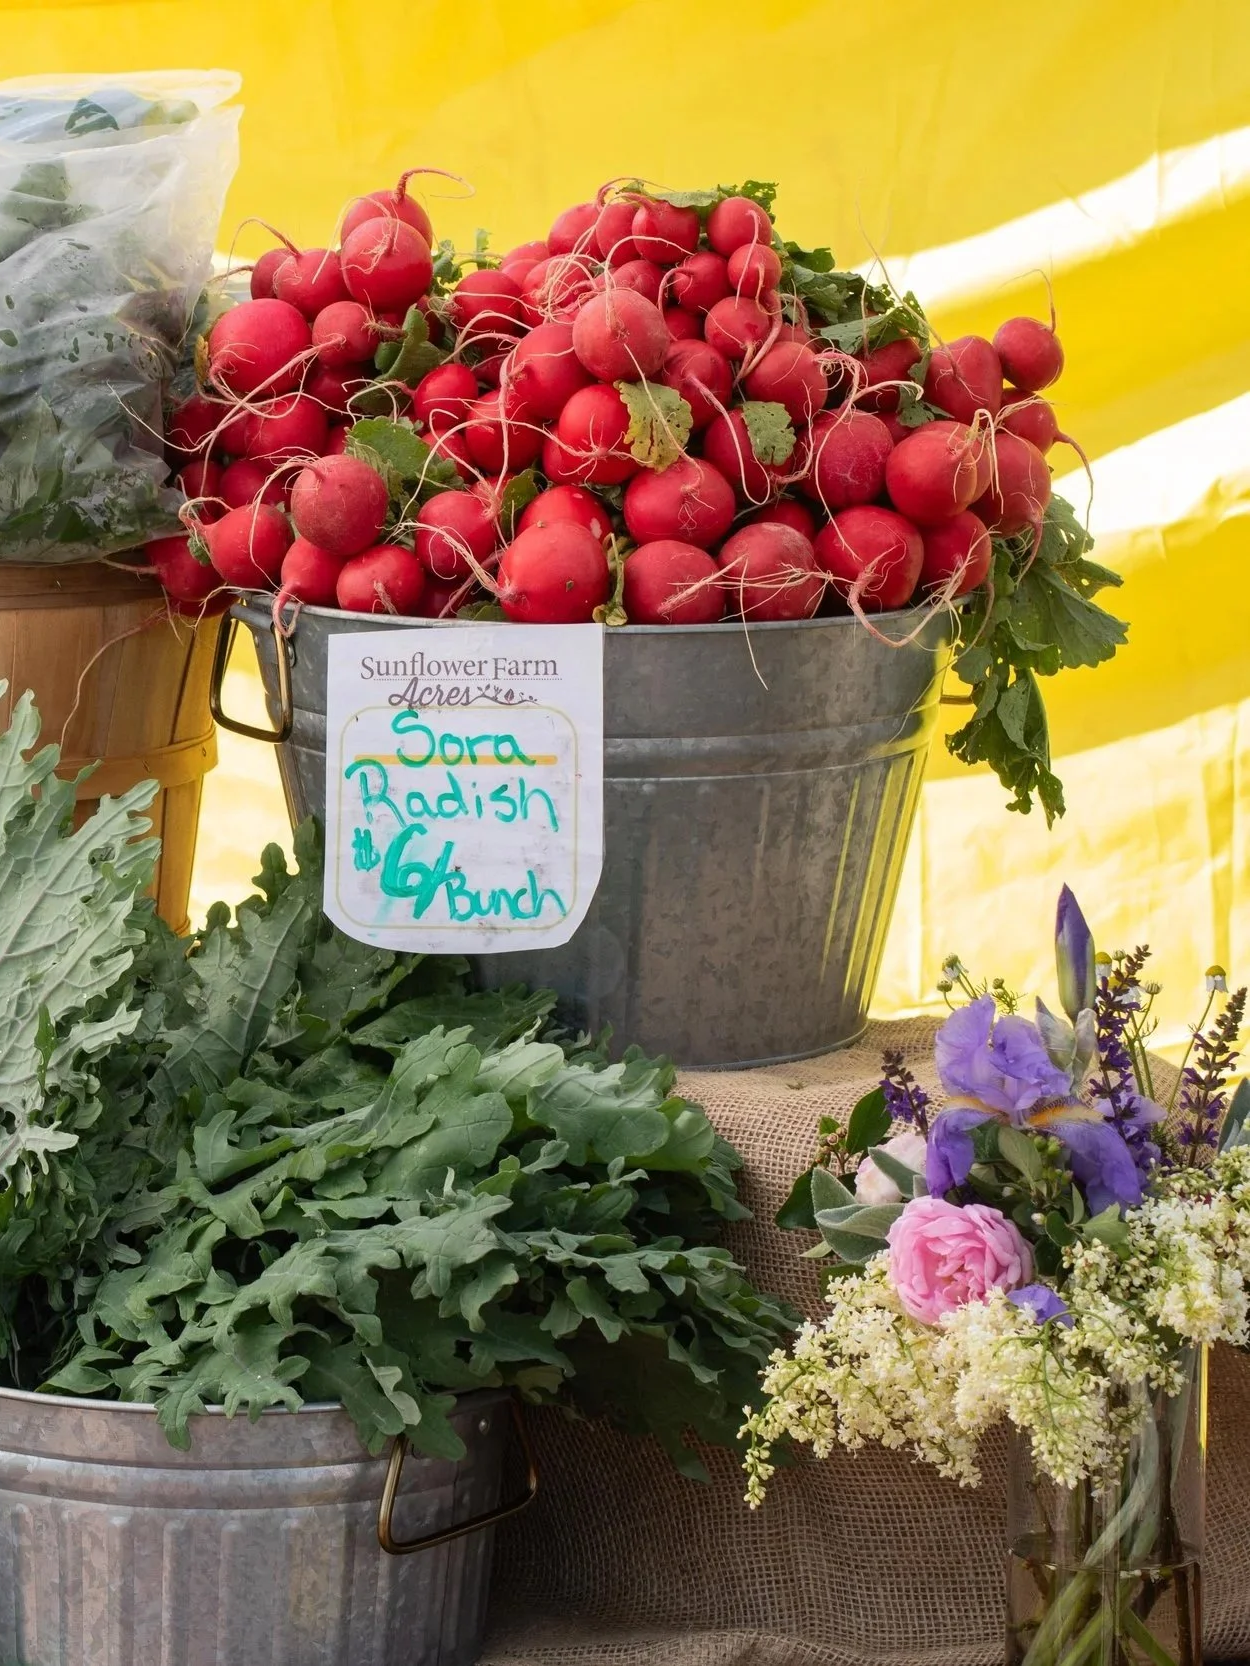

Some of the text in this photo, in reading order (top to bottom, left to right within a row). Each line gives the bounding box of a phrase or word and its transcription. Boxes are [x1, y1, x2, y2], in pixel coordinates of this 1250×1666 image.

[360, 651, 558, 681] Sunflower Farm
[388, 677, 472, 708] Acres
[391, 709, 536, 768] Sora
[345, 758, 559, 832] Radish
